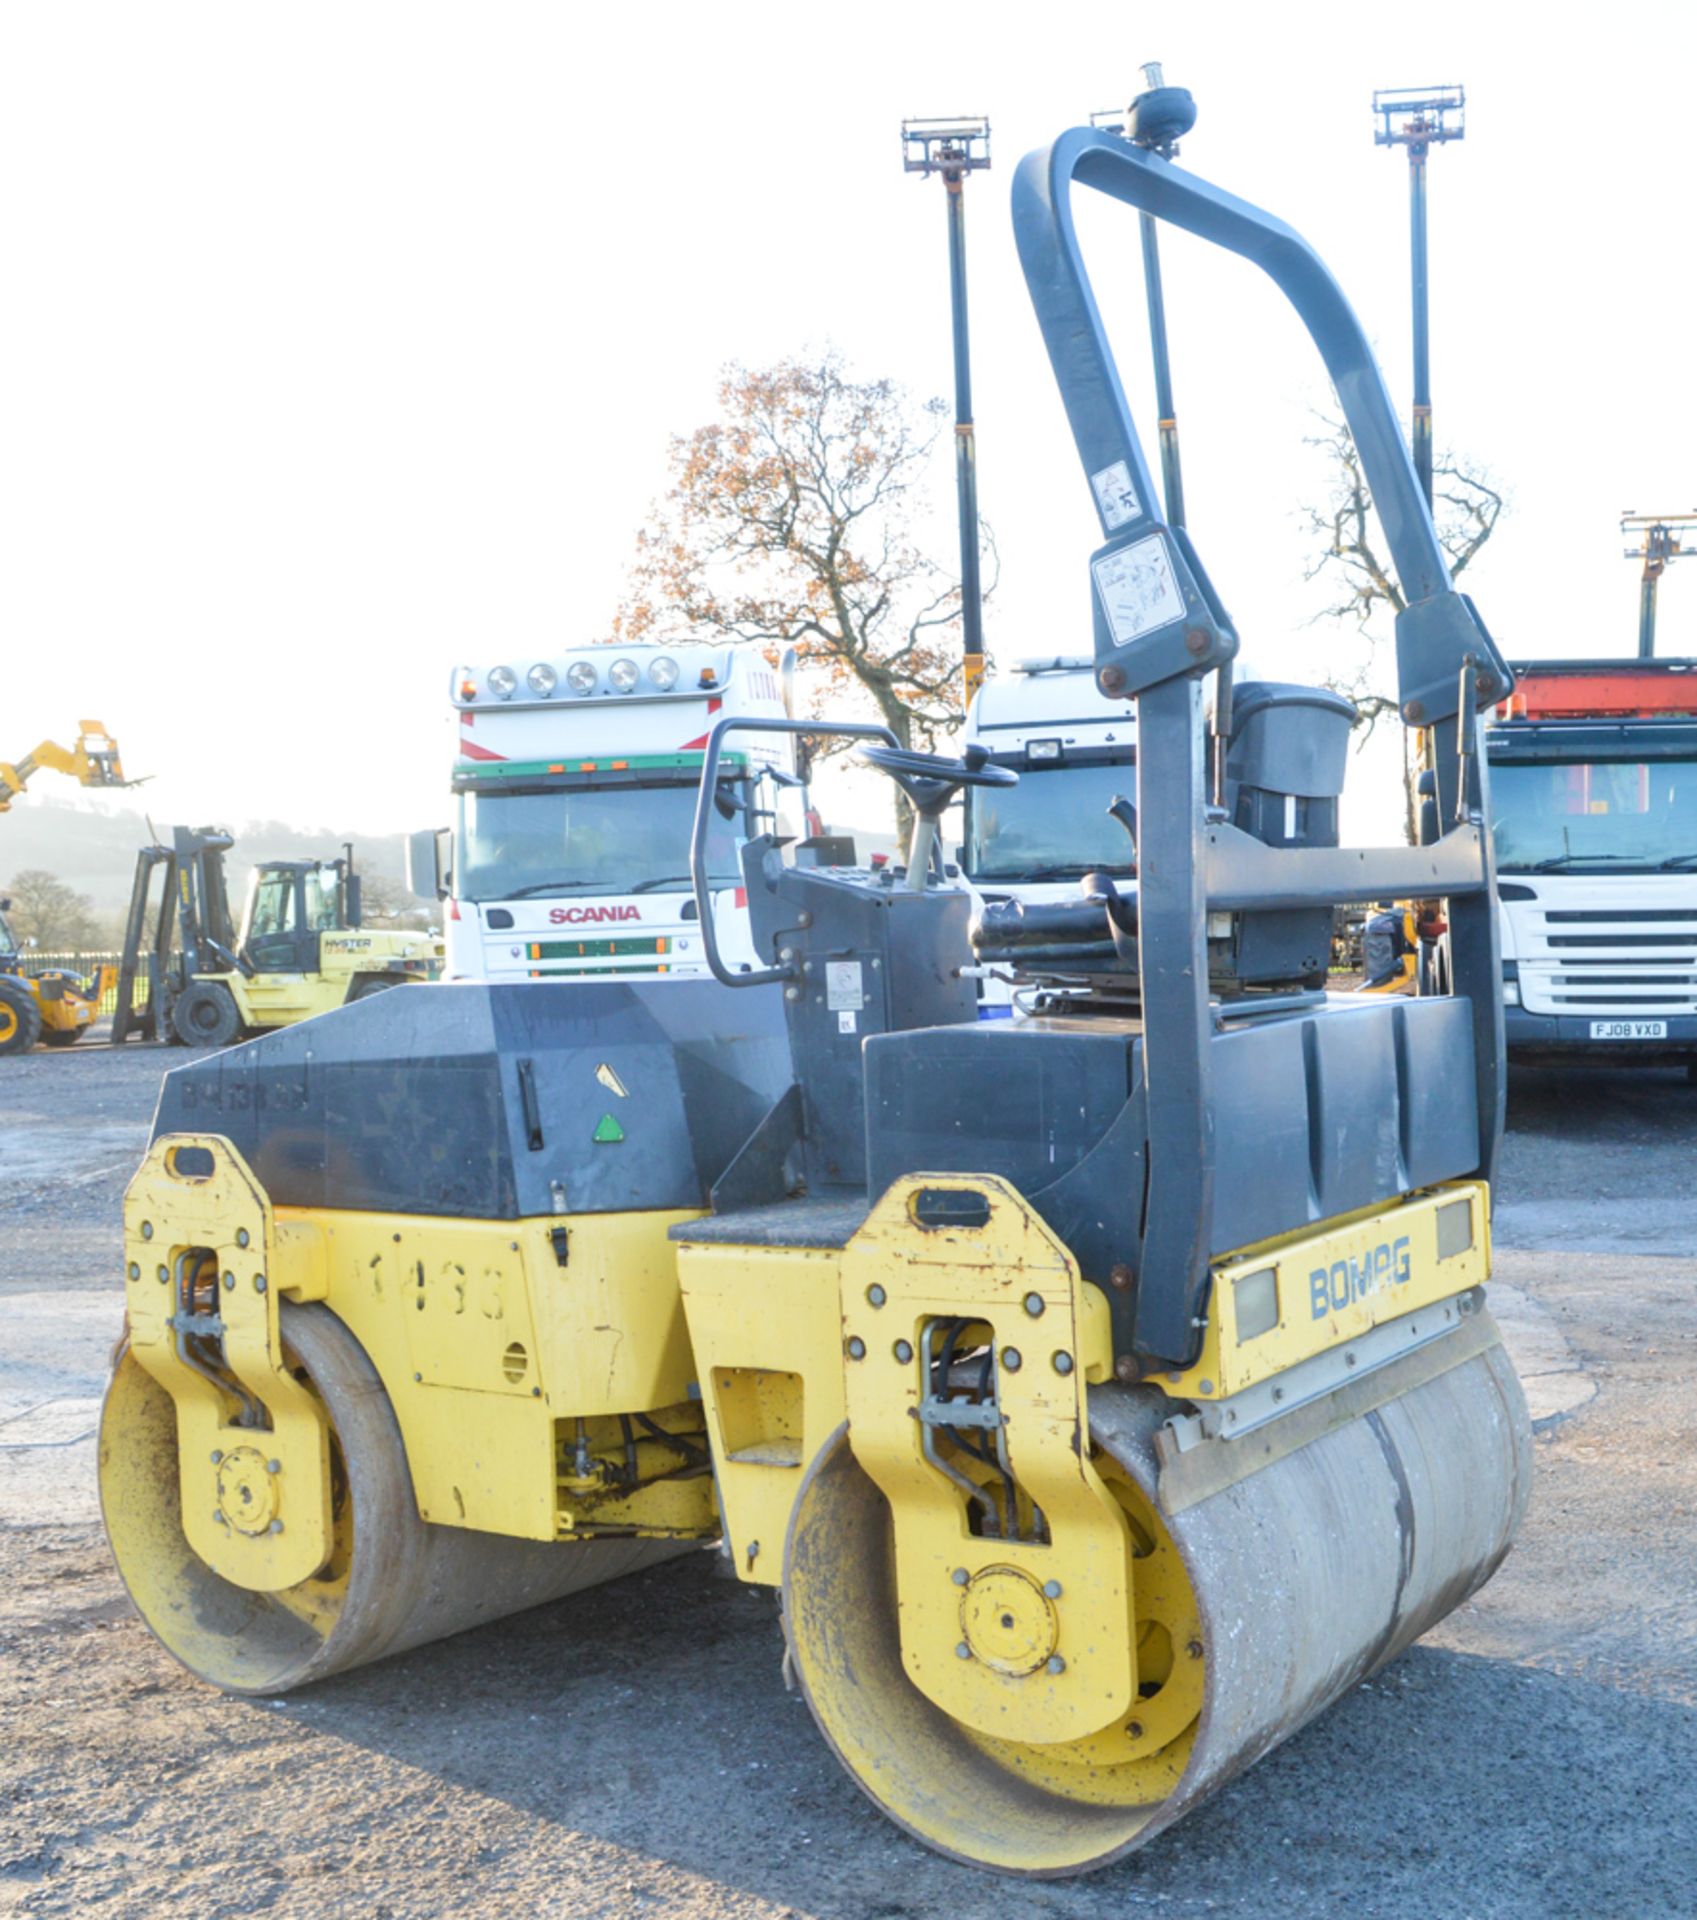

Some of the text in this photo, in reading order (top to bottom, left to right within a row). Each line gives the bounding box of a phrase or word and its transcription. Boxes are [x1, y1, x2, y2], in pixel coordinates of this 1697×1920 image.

[549, 905, 641, 924] SCANIA
[325, 938, 371, 948] HYSTER
[1597, 1023, 1661, 1036] FJ08 VXD
